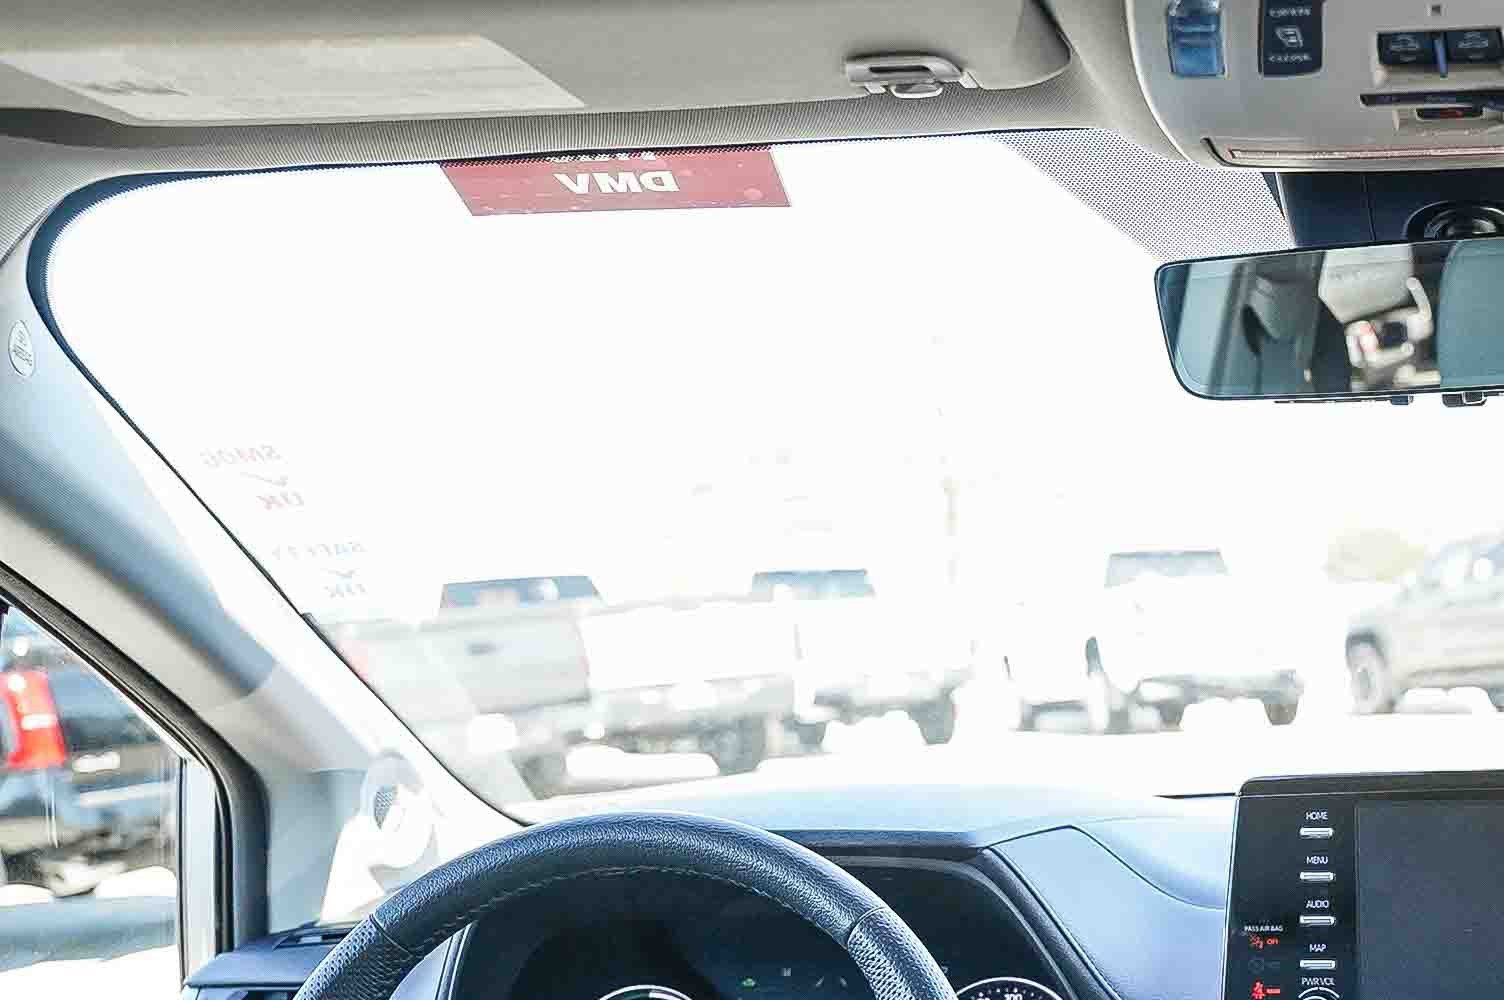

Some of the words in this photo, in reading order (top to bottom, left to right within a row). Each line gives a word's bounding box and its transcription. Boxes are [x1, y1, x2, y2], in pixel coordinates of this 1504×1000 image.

[1305, 811, 1328, 820] HOME
[1306, 855, 1328, 865] MENU
[1305, 899, 1330, 909] AUDIO
[1309, 943, 1327, 952] MAP
